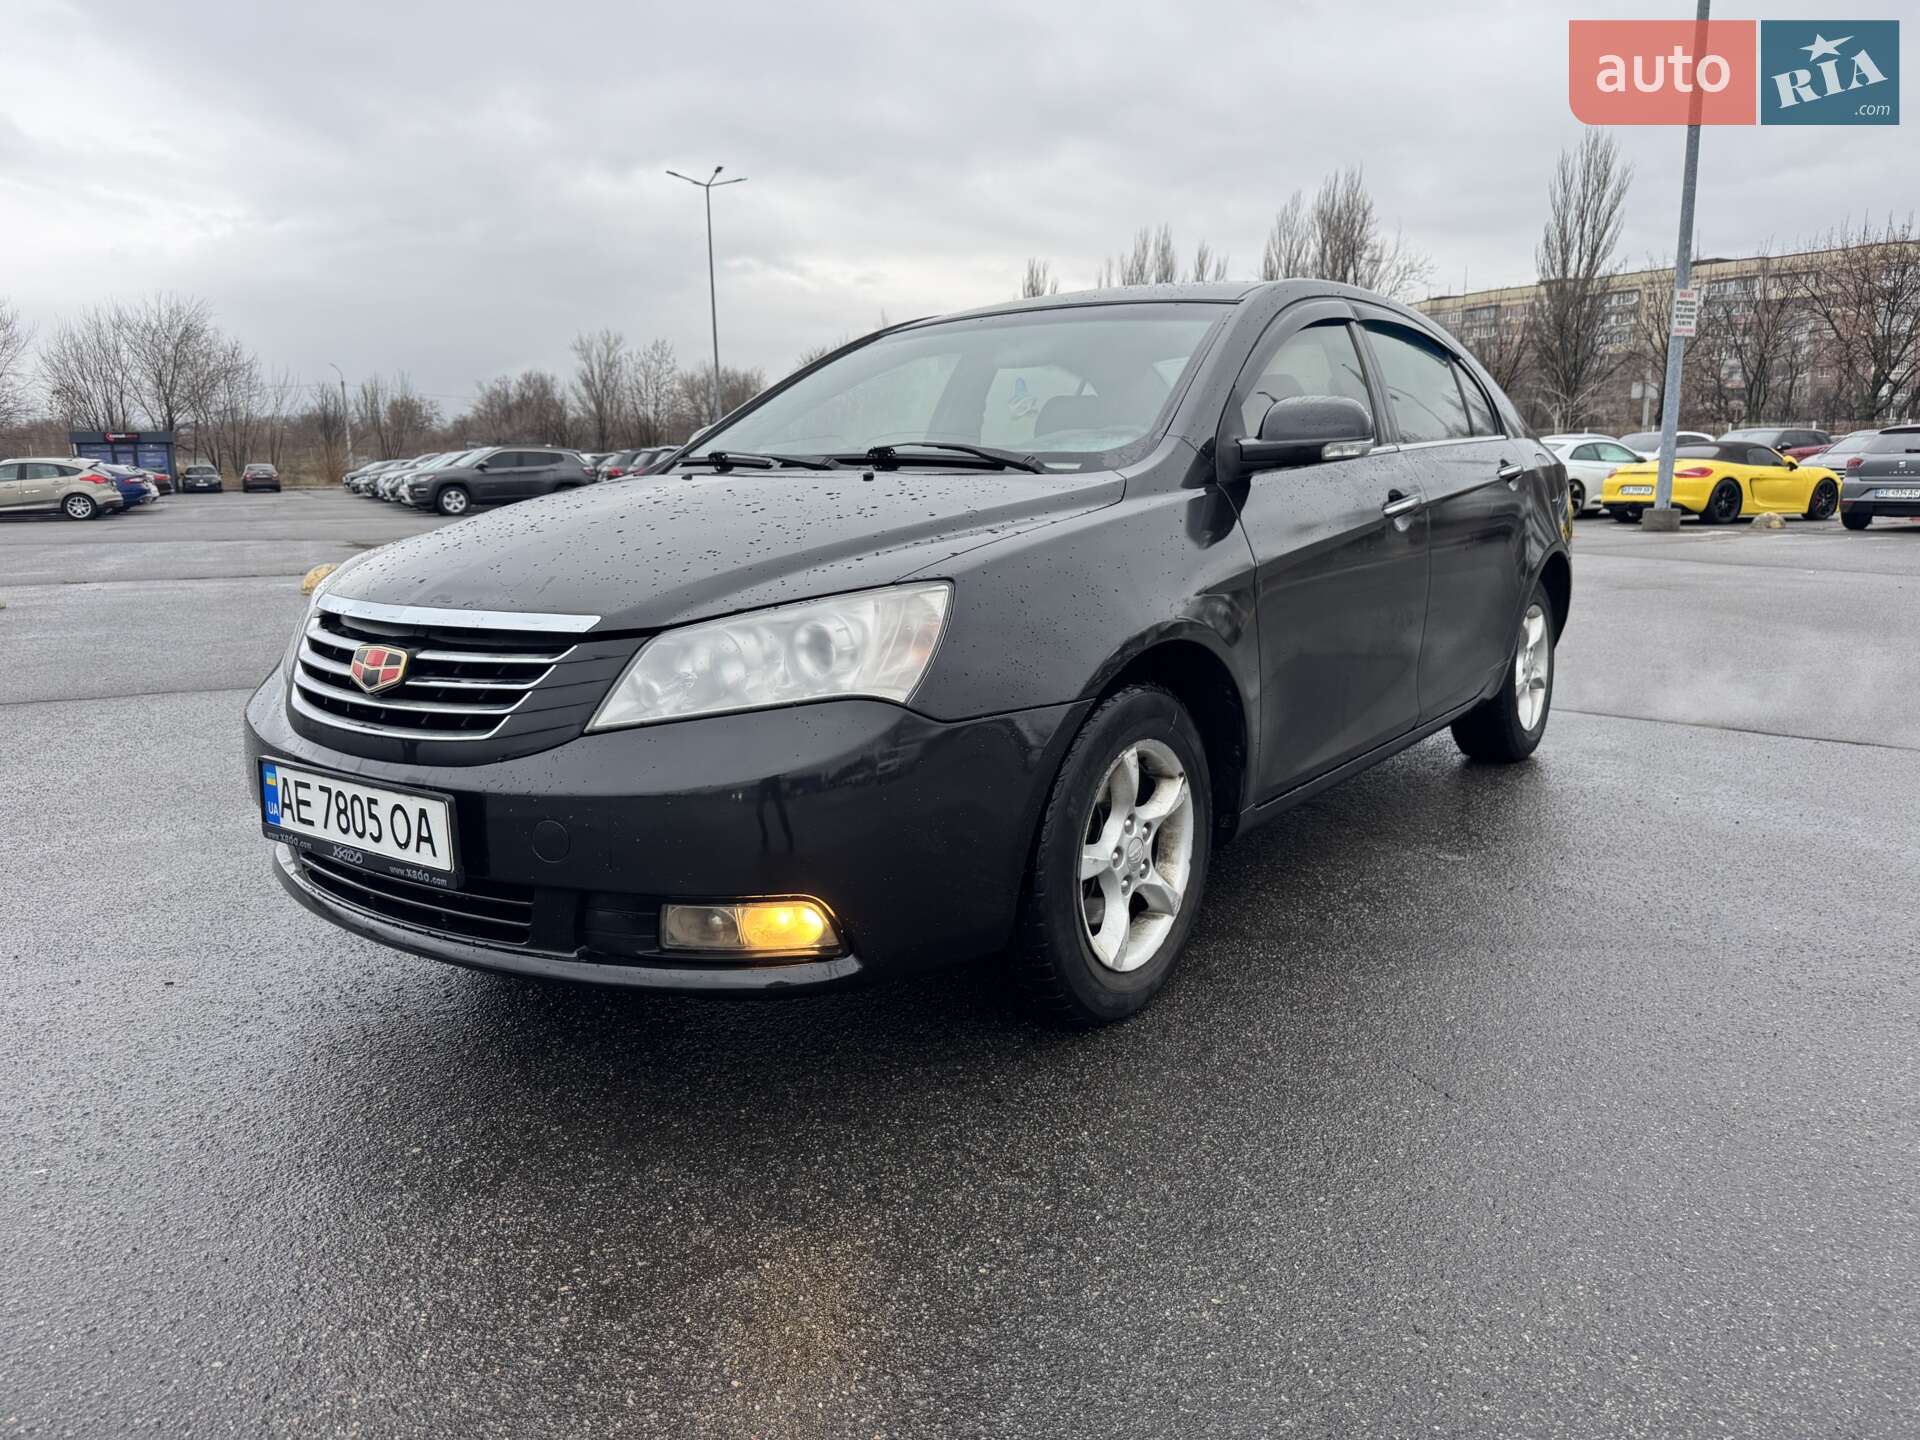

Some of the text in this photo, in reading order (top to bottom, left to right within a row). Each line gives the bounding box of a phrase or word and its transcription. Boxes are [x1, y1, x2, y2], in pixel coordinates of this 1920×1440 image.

[268, 801, 279, 816] UA
[318, 785, 383, 844] 7805
[390, 803, 437, 858] OA
